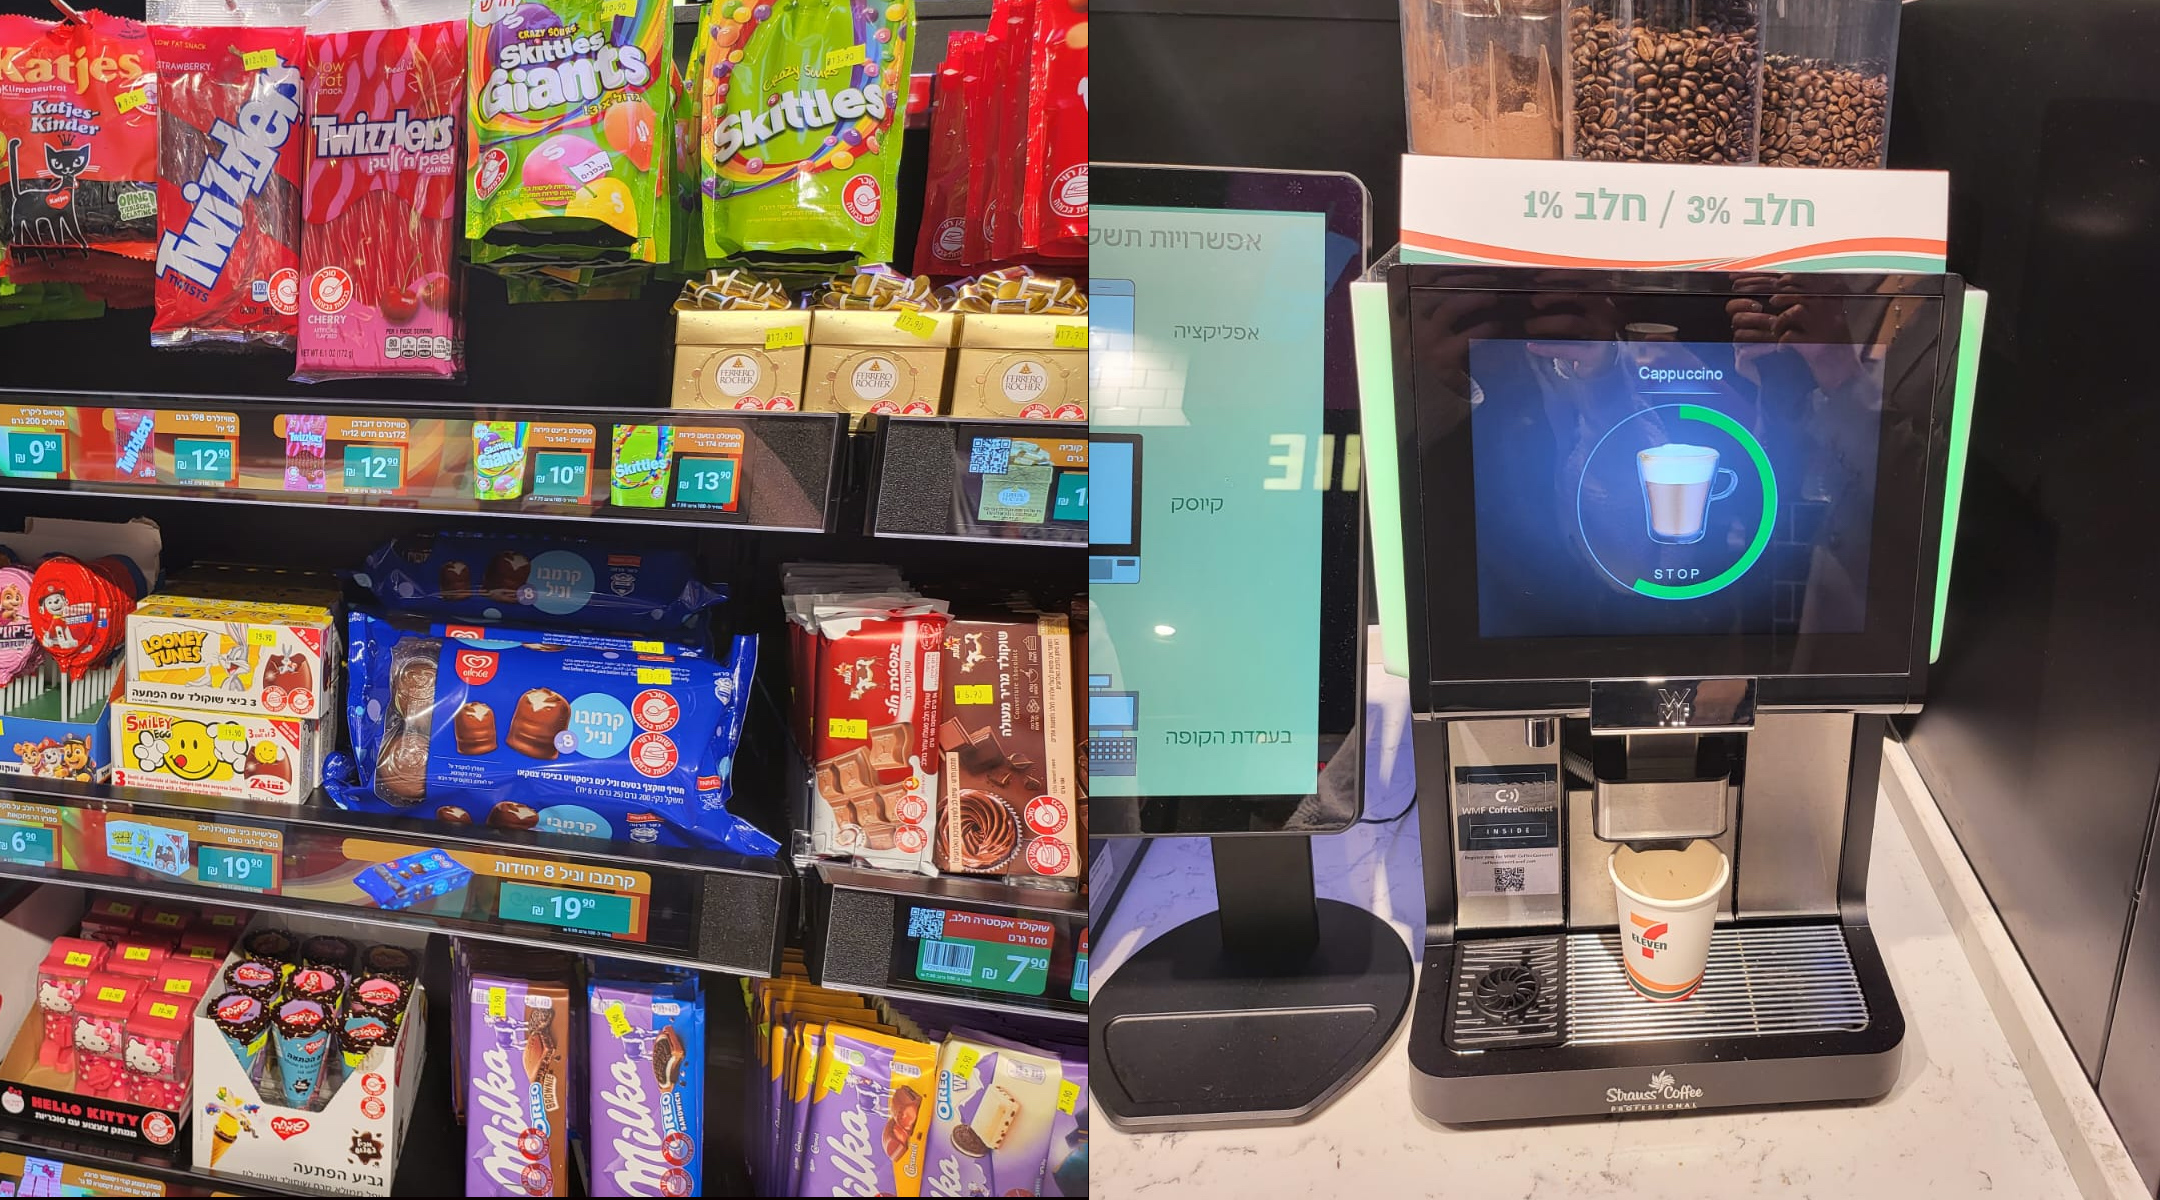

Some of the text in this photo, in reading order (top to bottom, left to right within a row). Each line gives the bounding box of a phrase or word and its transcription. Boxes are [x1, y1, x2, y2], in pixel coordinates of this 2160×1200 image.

[518, 25, 577, 39] CRAZY SOURS
[500, 31, 605, 69] Skittles
[0, 46, 142, 94] Katjes
[319, 61, 344, 72] low
[319, 74, 343, 87] fat
[480, 45, 651, 120] Giants
[763, 65, 800, 92] Crazy
[31, 100, 100, 119] Katjes-
[31, 117, 100, 135] Kinder
[714, 84, 886, 163] Skittles
[311, 110, 454, 157] Twizzlers
[156, 54, 302, 290] Twizzlers
[581, 163, 610, 179] מבפנים
[858, 177, 875, 188] סוכר
[1524, 187, 1815, 228] חלב 3% / חלב 1%
[1150, 230, 1263, 253] אפשרויות
[318, 270, 336, 278] סוכר
[168, 274, 209, 303] TWISTS
[308, 315, 347, 324] CHERRY
[1173, 323, 1260, 344] אפליקציה
[719, 369, 754, 378] FERRERO
[719, 376, 754, 385] ROCHER
[855, 372, 890, 382] FERRERO
[1006, 376, 1041, 384] FERRERO
[1638, 365, 1724, 385] Cappuccino
[855, 380, 890, 388] ROCHER
[1006, 382, 1041, 392] ROCHER
[26, 417, 40, 425] 200
[176, 413, 204, 422] 198 גרם
[361, 430, 377, 438] חדש
[1058, 444, 1083, 453] קוביה
[615, 459, 667, 478] Skittles
[1170, 494, 1224, 516] קיוסק
[537, 567, 582, 584] קרמבו
[1653, 568, 1701, 580] STOP
[523, 588, 534, 599] 8
[545, 584, 572, 600] וניל
[141, 630, 208, 653] LOONEY
[255, 632, 273, 642] 19.90
[148, 646, 203, 668] TUNES
[885, 643, 901, 716] אקסטרה חלב
[904, 661, 912, 700] שוקולד חלב
[997, 630, 1012, 737] שוקולד מריר מעולה
[1010, 649, 1020, 720] Couverture chocolate
[132, 688, 257, 708] 3 ביצי שוקולד עם הפתעה
[647, 691, 666, 700] סוכר
[575, 709, 624, 731] קרמבו
[153, 730, 171, 739] EGG
[224, 728, 242, 738] 19.90
[563, 734, 574, 748] 8
[585, 727, 613, 746] וניל
[638, 734, 672, 747] שומן רווי
[1165, 728, 1292, 748] בעמדת הקופה
[114, 770, 126, 787] 3
[541, 772, 563, 782] בציפוי
[594, 778, 606, 787] עם
[606, 779, 619, 789] וניל
[620, 781, 642, 791] בטעם
[642, 783, 665, 794] מוקצף
[667, 786, 685, 795] חטיף
[599, 789, 684, 805] משקל 200 גרם גרם
[1026, 807, 1035, 824] סוכר
[1462, 804, 1554, 815] WMF CoffeeConnect
[237, 828, 250, 836] ביצי
[546, 816, 597, 833] קרמבו
[1486, 827, 1531, 835] INSIDE
[495, 860, 636, 890] קרמבו וניל 8 יחידות
[973, 917, 1050, 933] שוקולד אקסטרה
[1008, 933, 1048, 945] 100 גרם
[545, 1073, 559, 1111] BROWNIE
[937, 1069, 954, 1121] OREO
[1606, 1085, 1704, 1103] Strauss Coffee
[31, 1096, 140, 1127] HELLO KITTY
[673, 1091, 687, 1131] SANDWICH
[1611, 1102, 1698, 1112] PROFESSIONAL
[35, 1111, 137, 1138] ממתק צעצוע עם סוכריות
[482, 1043, 528, 1195] Milka
[601, 1054, 662, 1197] Milka
[904, 1142, 919, 1178] Caramel
[293, 1162, 384, 1187] גביע הפתעה
